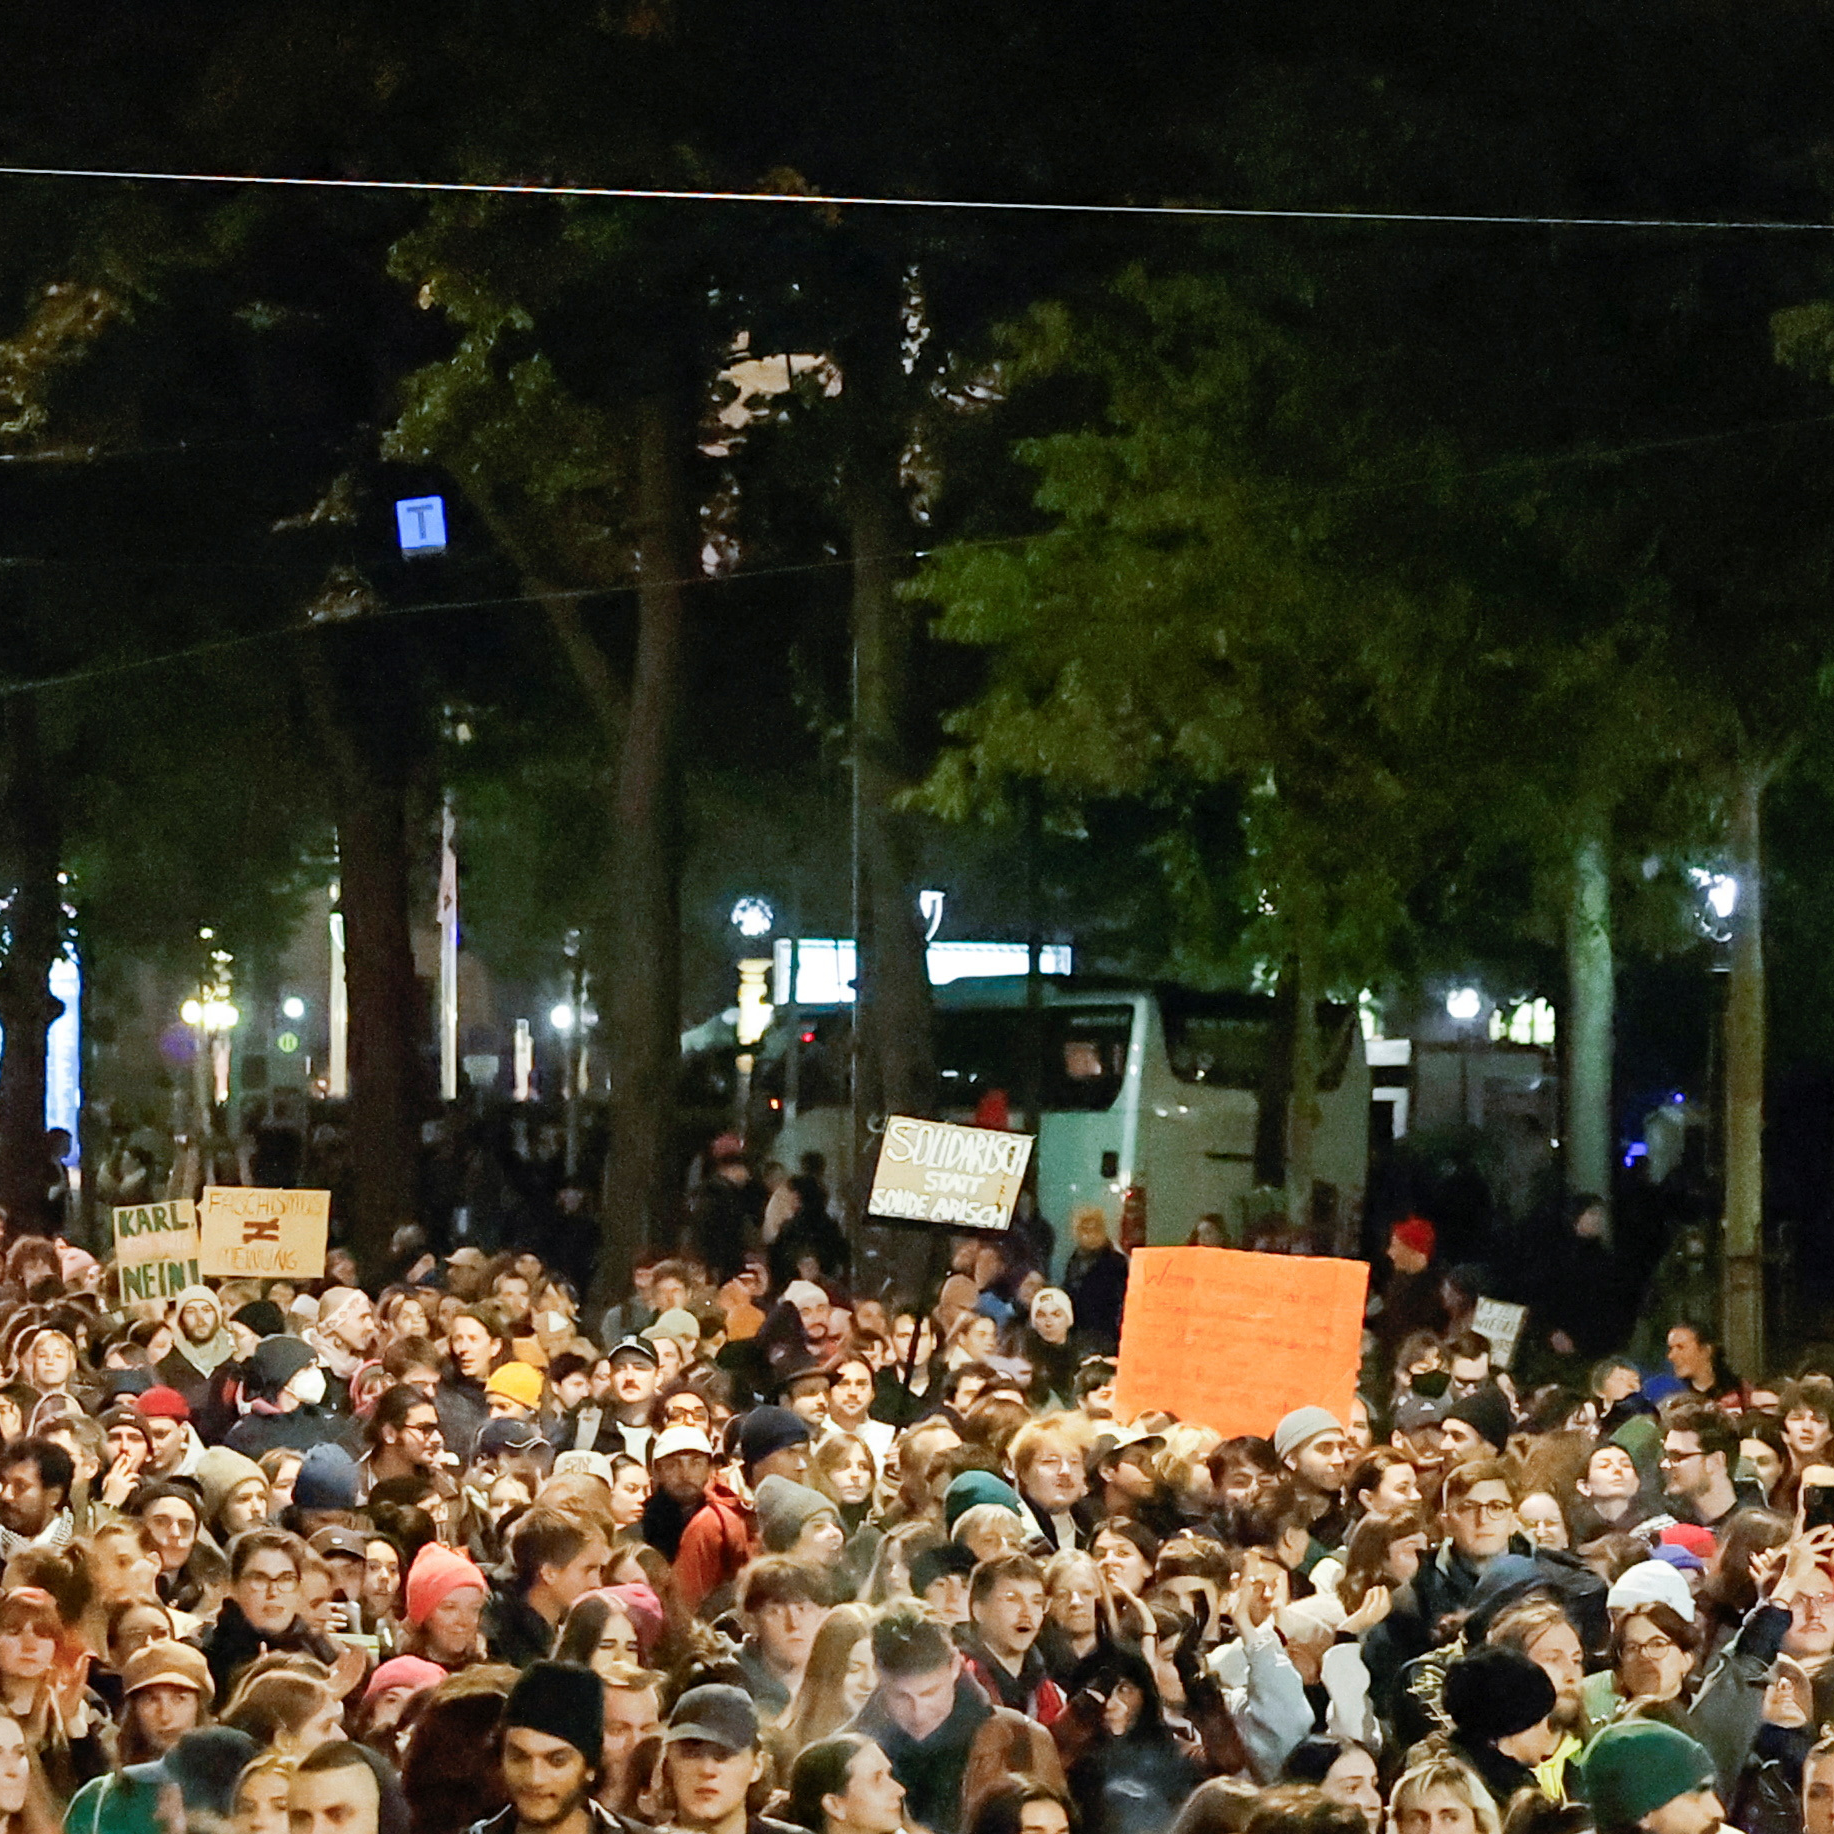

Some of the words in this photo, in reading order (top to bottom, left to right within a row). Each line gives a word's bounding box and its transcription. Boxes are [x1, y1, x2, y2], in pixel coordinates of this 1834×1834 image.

[406, 504, 433, 539] T
[886, 1121, 1033, 1178] SOLIDARISCH
[924, 1170, 986, 1195] STATT
